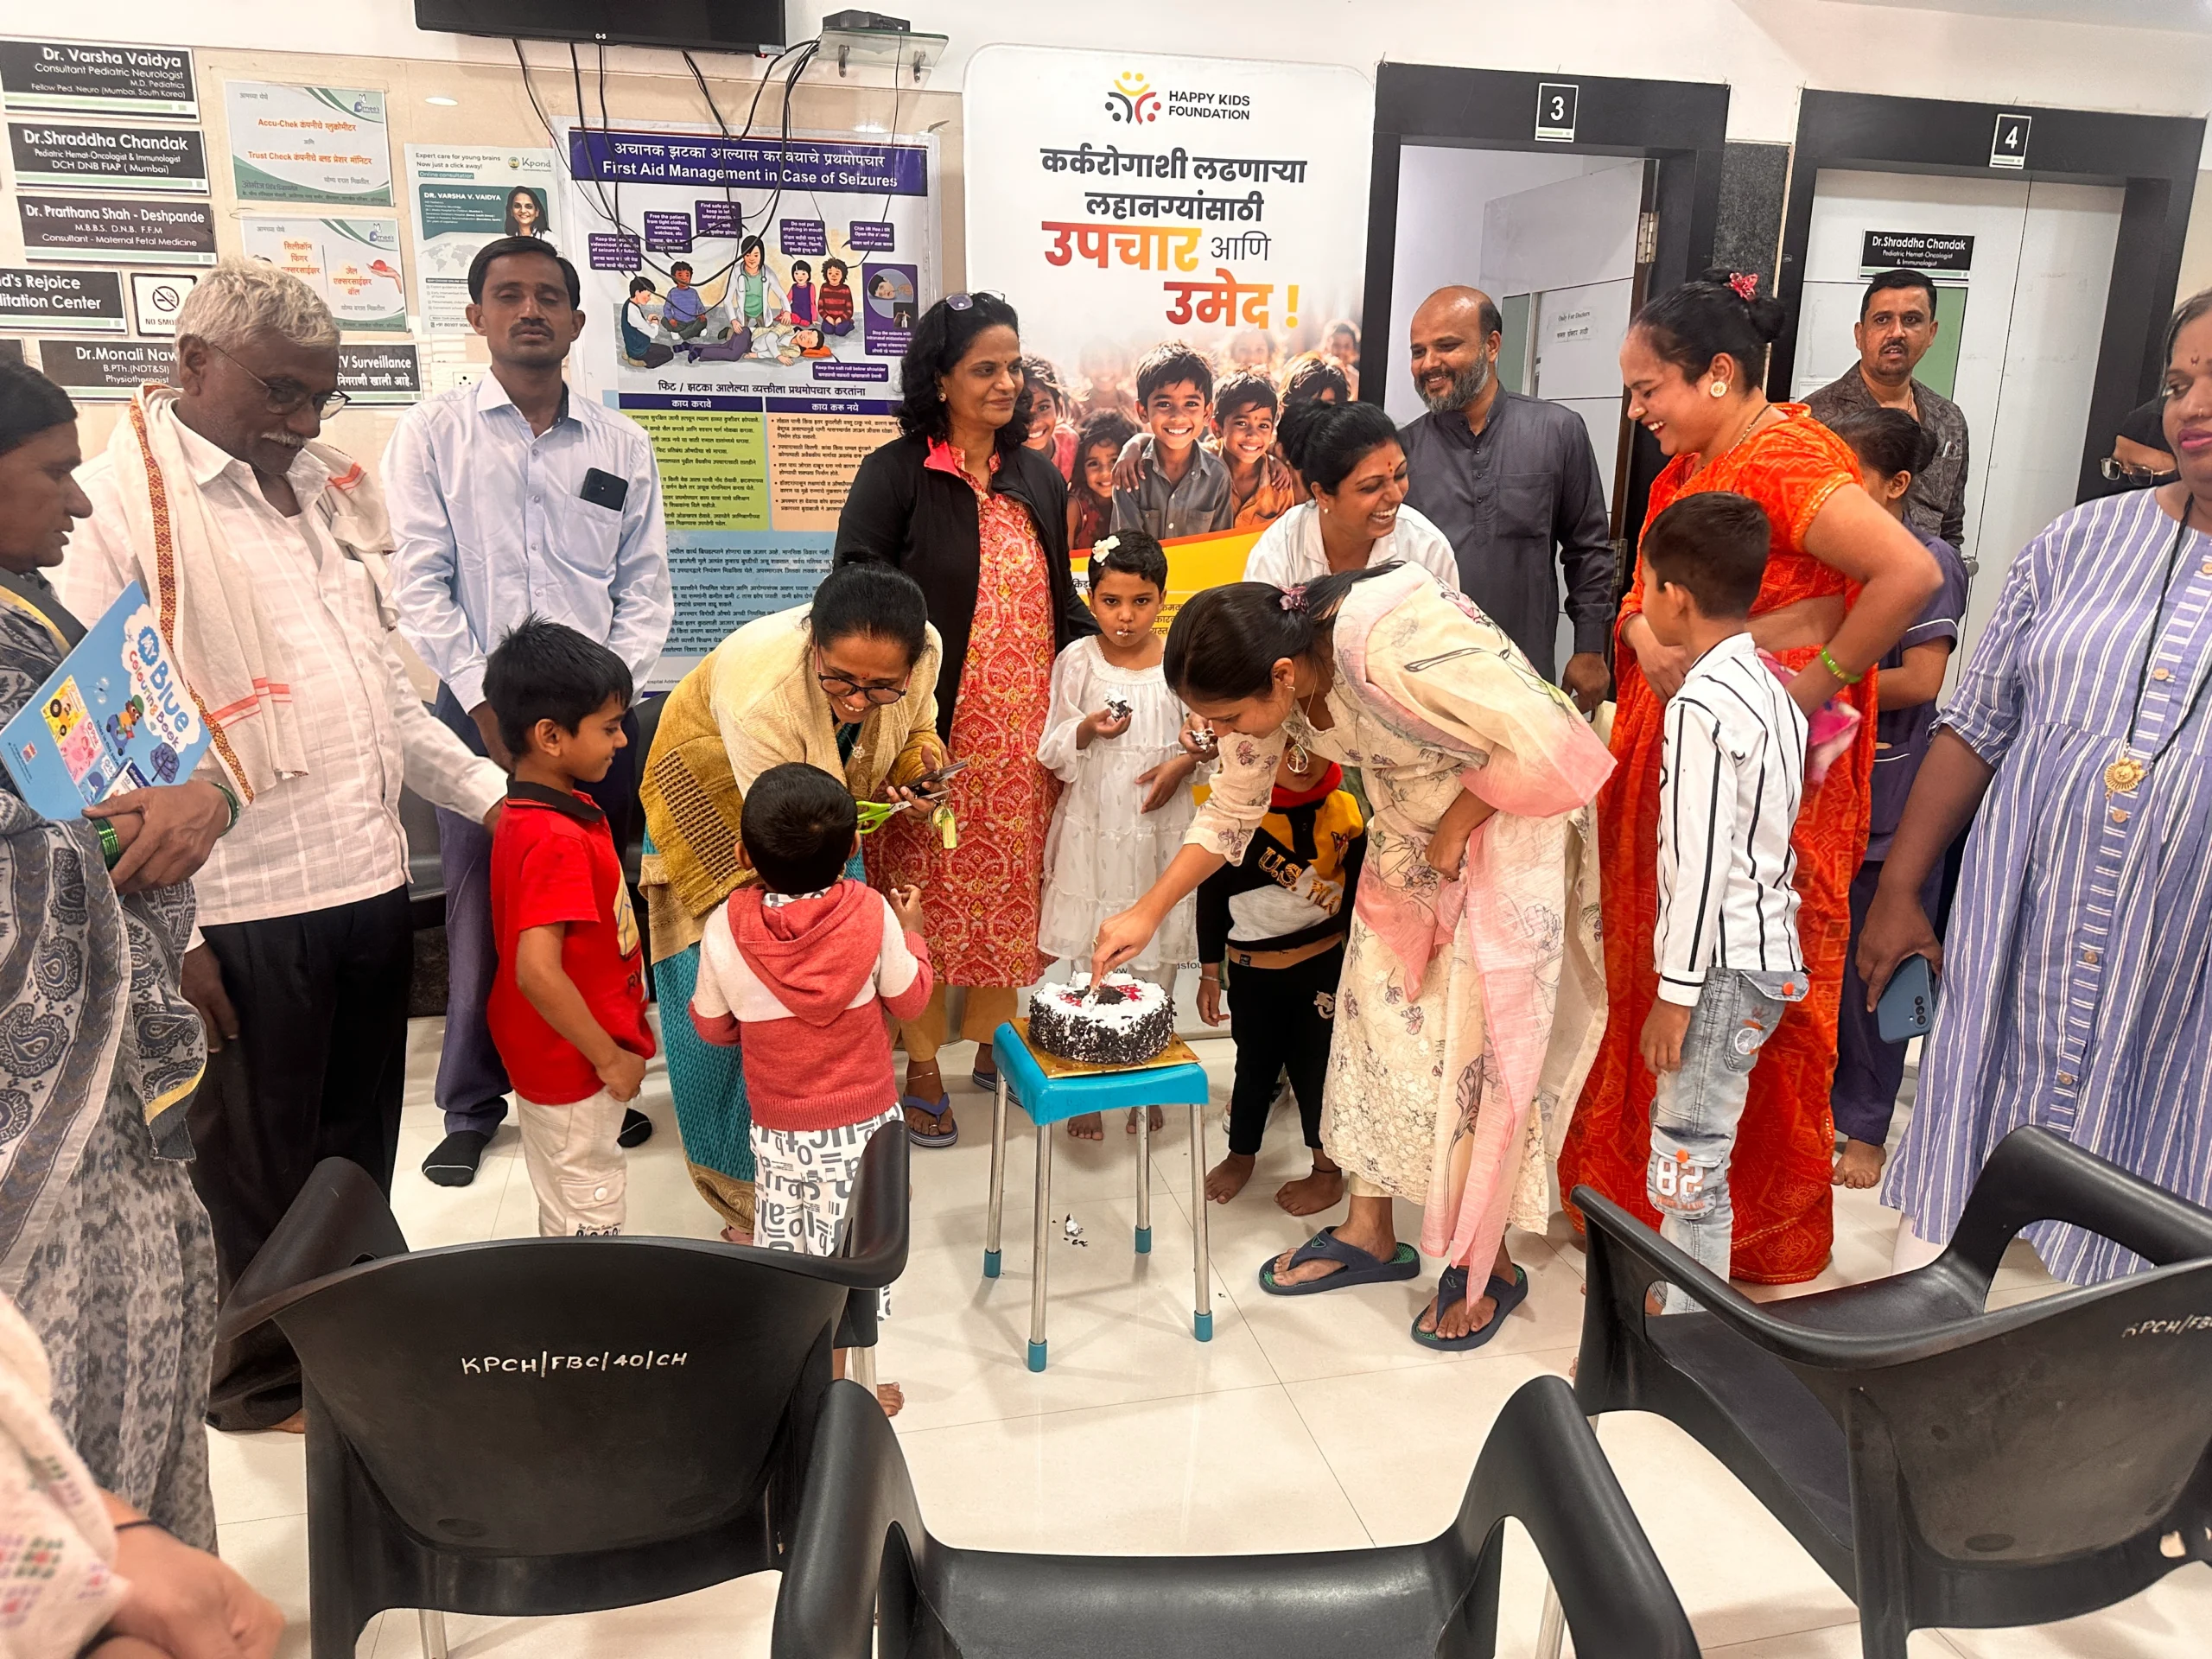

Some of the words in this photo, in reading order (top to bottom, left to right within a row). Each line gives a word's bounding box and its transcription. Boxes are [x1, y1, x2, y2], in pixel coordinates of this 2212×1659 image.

[43, 48, 64, 61] Dr.
[67, 48, 122, 64] Varsha
[125, 52, 181, 68] Vaidya
[35, 63, 86, 74] Consultant
[89, 66, 130, 76] Pediatric
[132, 68, 183, 80] Neurologist
[58, 84, 73, 92] Ped.
[161, 89, 186, 99] Korea)
[149, 79, 184, 88] Pediatrics
[1169, 90, 1215, 104] HAPPY
[1218, 94, 1250, 106] KIDS
[1169, 105, 1249, 120] FOUNDATION
[1550, 96, 1564, 121] 3
[258, 118, 298, 129] Accu-Chek
[300, 119, 322, 130] कंपनीचे
[23, 130, 116, 147] Dr.Shraddha
[120, 134, 188, 151] Chandak
[2005, 125, 2018, 149] 4
[35, 148, 63, 158] Pediatric
[66, 149, 127, 162] Hemat-Oncologist
[136, 153, 181, 163] Immunologist
[248, 151, 267, 160] Trust
[270, 152, 291, 161] Check
[294, 152, 316, 162] कंपनीचे
[522, 156, 551, 168] Kpond
[614, 143, 664, 157] अचानक
[668, 145, 706, 161] झटका
[823, 149, 886, 168] प्रथमोपचार
[1040, 143, 1186, 180] कर्करोगाशी
[53, 160, 74, 169] DCH
[78, 161, 99, 170] DNB
[102, 162, 121, 171] FIAP
[130, 163, 168, 175] Mumbai)
[603, 161, 636, 175] First
[640, 162, 664, 176] Aid
[669, 164, 760, 181] Management
[765, 169, 778, 181] in
[781, 169, 817, 184] Case
[821, 172, 835, 185] of
[839, 172, 897, 188] Seizures
[1084, 188, 1264, 222] लहानग्यांसाठी
[25, 204, 42, 217] Dr.
[44, 204, 99, 219] Prarthana
[102, 207, 130, 220] Shah
[141, 208, 205, 224] Deshpande
[75, 224, 107, 232] M.B.B.S.
[111, 225, 137, 233] D.N.B.
[141, 226, 162, 234] F.F.M
[42, 233, 88, 244] Consultant
[96, 236, 133, 245] Maternal
[136, 237, 156, 245] Fetal
[158, 238, 197, 246] Medicine
[1041, 220, 1202, 272] उपचार
[1211, 231, 1272, 261] आणि
[1872, 236, 1924, 249] Dr.Shraddha
[1926, 238, 1966, 251] Chandak
[25, 274, 80, 292] Rejoice
[52, 295, 101, 310] Center
[1163, 268, 1274, 329] उमेद
[76, 346, 143, 361] Dr.Monali
[352, 355, 411, 369] Surveillance
[369, 373, 391, 386] खाली
[394, 372, 414, 387] आहे.
[658, 379, 677, 391] फिट
[688, 382, 712, 394] झटका
[716, 381, 749, 393] आलेल्या
[753, 382, 786, 394] व्यक्तीला
[788, 384, 831, 396] प्रथमोपचार
[835, 385, 866, 397] करतांना
[671, 399, 689, 408] काय
[691, 397, 711, 409] करावे
[811, 403, 827, 411] काय
[846, 401, 859, 412] नये
[130, 650, 159, 716] Colouring
[156, 711, 180, 749] Book
[149, 660, 189, 733] Blue
[1656, 1157, 1704, 1197] 82
